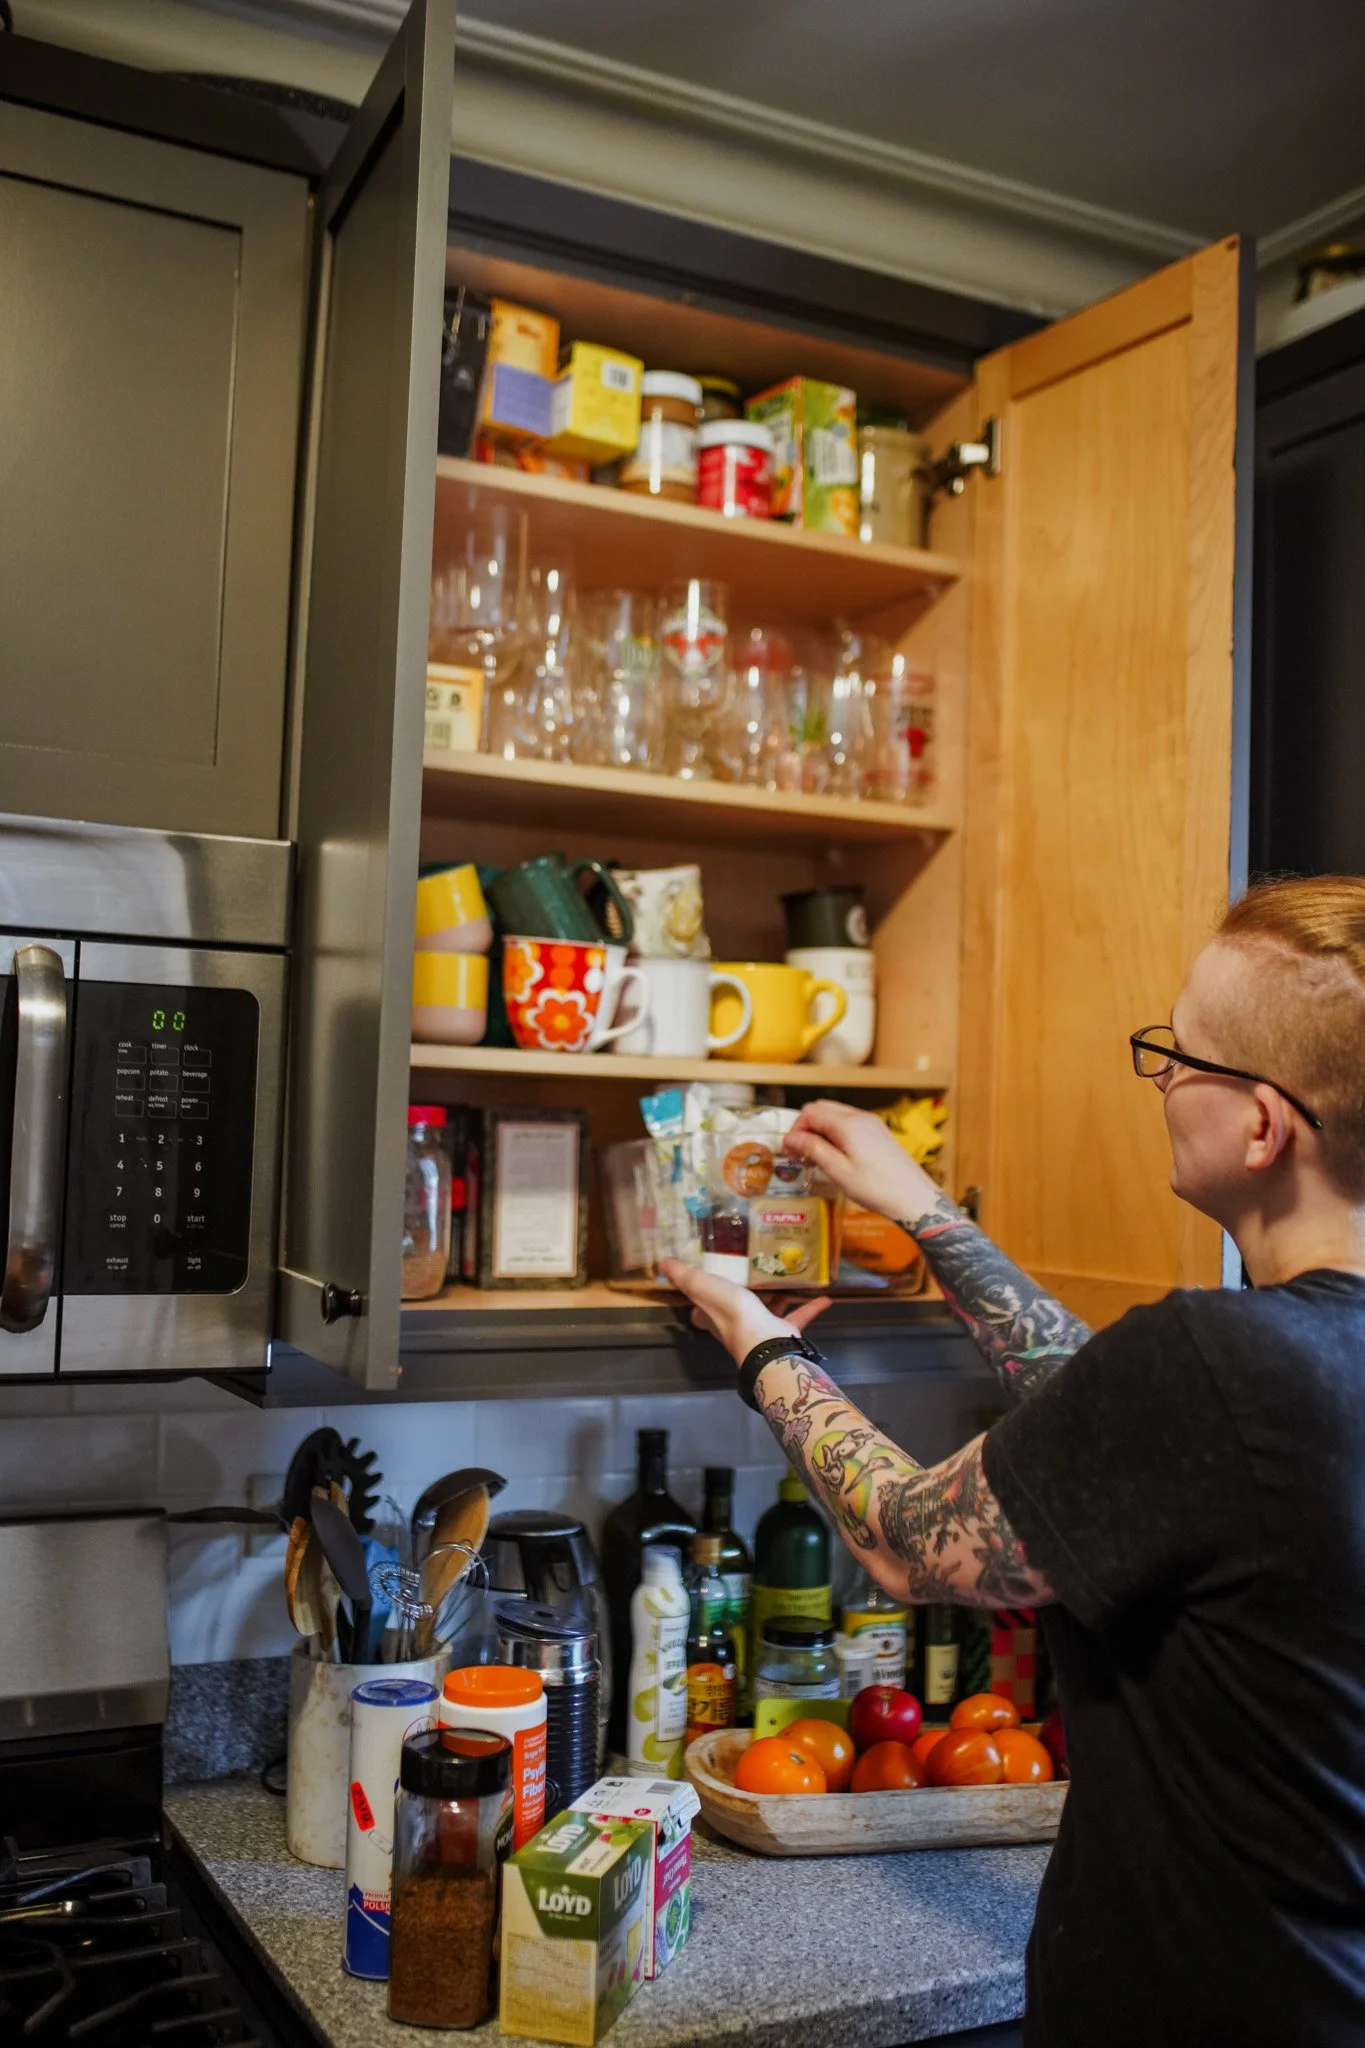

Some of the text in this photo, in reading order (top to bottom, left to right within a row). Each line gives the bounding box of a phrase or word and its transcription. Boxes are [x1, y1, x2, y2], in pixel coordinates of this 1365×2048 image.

[184, 1044, 199, 1052] clock
[116, 1068, 141, 1076] popcorn
[149, 1069, 169, 1077] potato
[182, 1070, 208, 1079] beverage
[148, 1095, 169, 1103] defrost
[181, 1097, 199, 1105] power
[119, 1133, 125, 1144] 1
[158, 1134, 165, 1144] 2
[196, 1135, 203, 1146] 3
[117, 1160, 124, 1170] 4
[156, 1161, 163, 1171] 5
[195, 1162, 202, 1172] 6
[116, 1186, 123, 1196] 7
[155, 1187, 162, 1197] 8
[193, 1188, 200, 1198] 9
[109, 1214, 127, 1223] stop
[153, 1213, 161, 1224] 0
[187, 1215, 205, 1223] start
[188, 1257, 202, 1265] light
[535, 1823, 588, 1854] LOYD
[614, 1855, 642, 1911] LOYD
[364, 1891, 390, 1899] PRODUK
[363, 1900, 391, 1911] POLSK
[538, 1886, 593, 1916] LOYD
